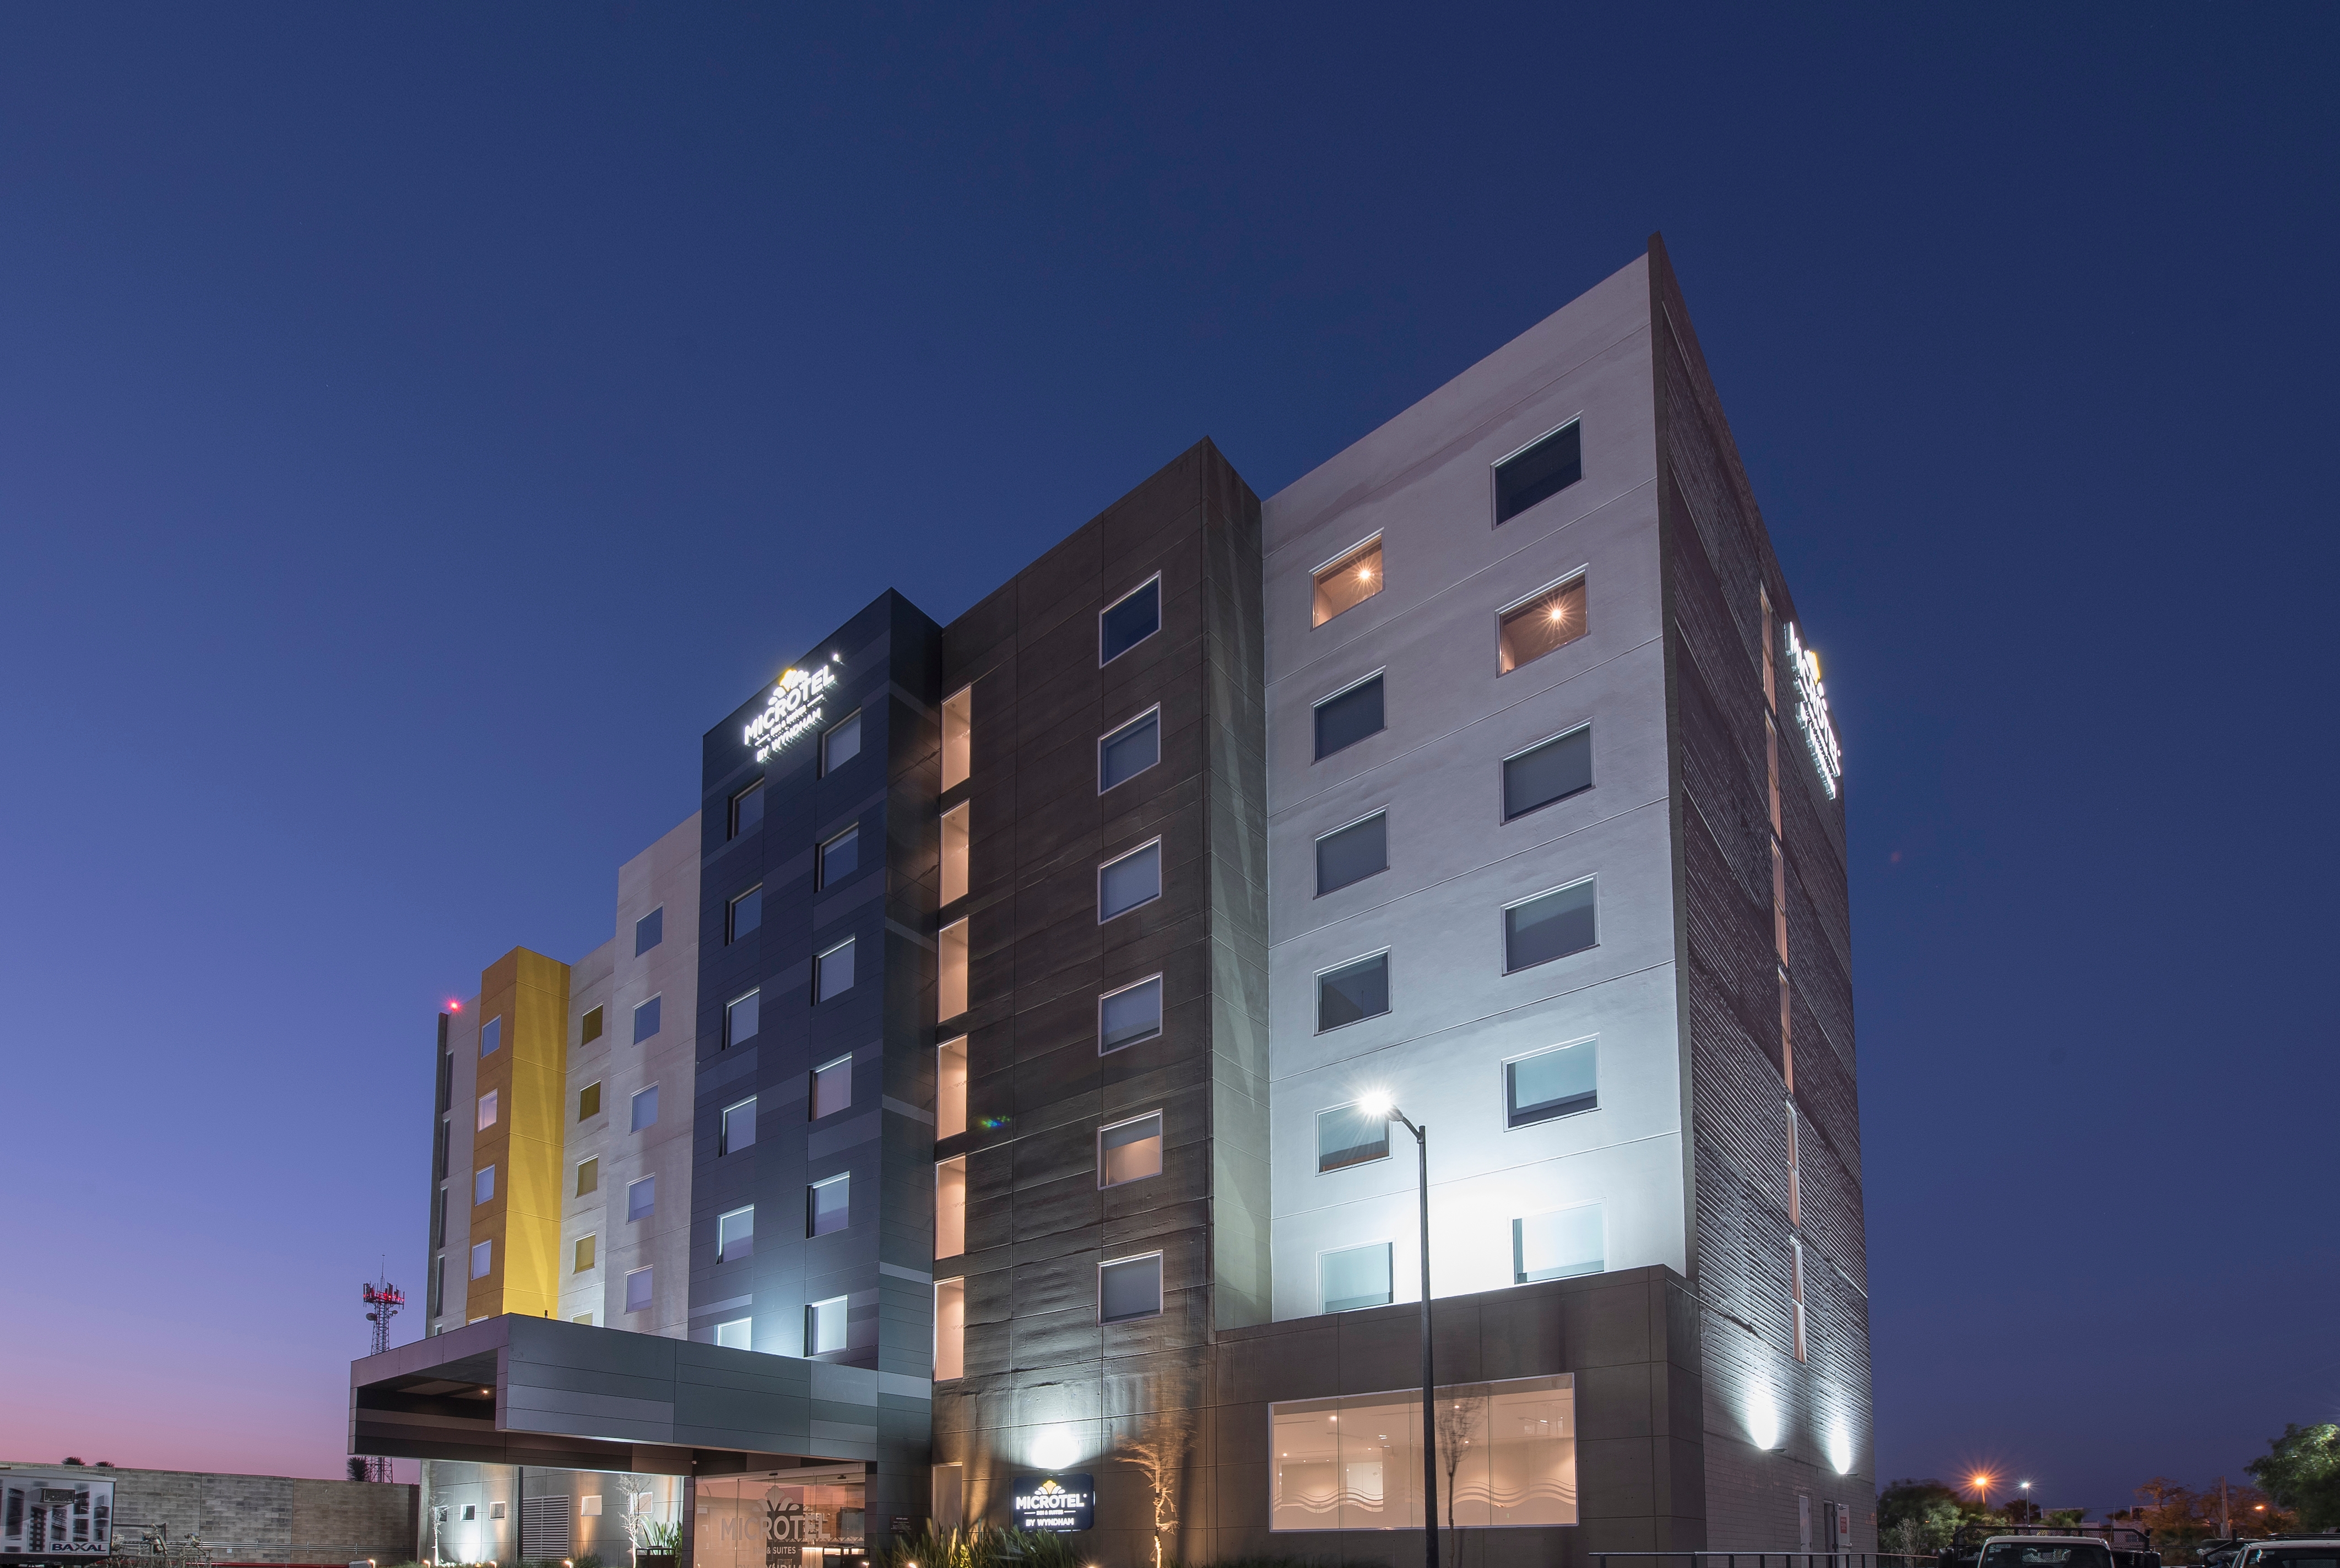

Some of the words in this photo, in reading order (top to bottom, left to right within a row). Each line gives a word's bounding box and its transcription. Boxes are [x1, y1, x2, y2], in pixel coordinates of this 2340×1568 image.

[744, 665, 835, 745] MICROTEL
[771, 707, 821, 751] WYNDHAM
[1016, 1493, 1084, 1510] MICROTEL
[721, 1515, 830, 1541] MICROTEL
[1037, 1518, 1074, 1526] WYNDHAM
[52, 1543, 106, 1551] BAXAL
[772, 1546, 796, 1554] SUITES
